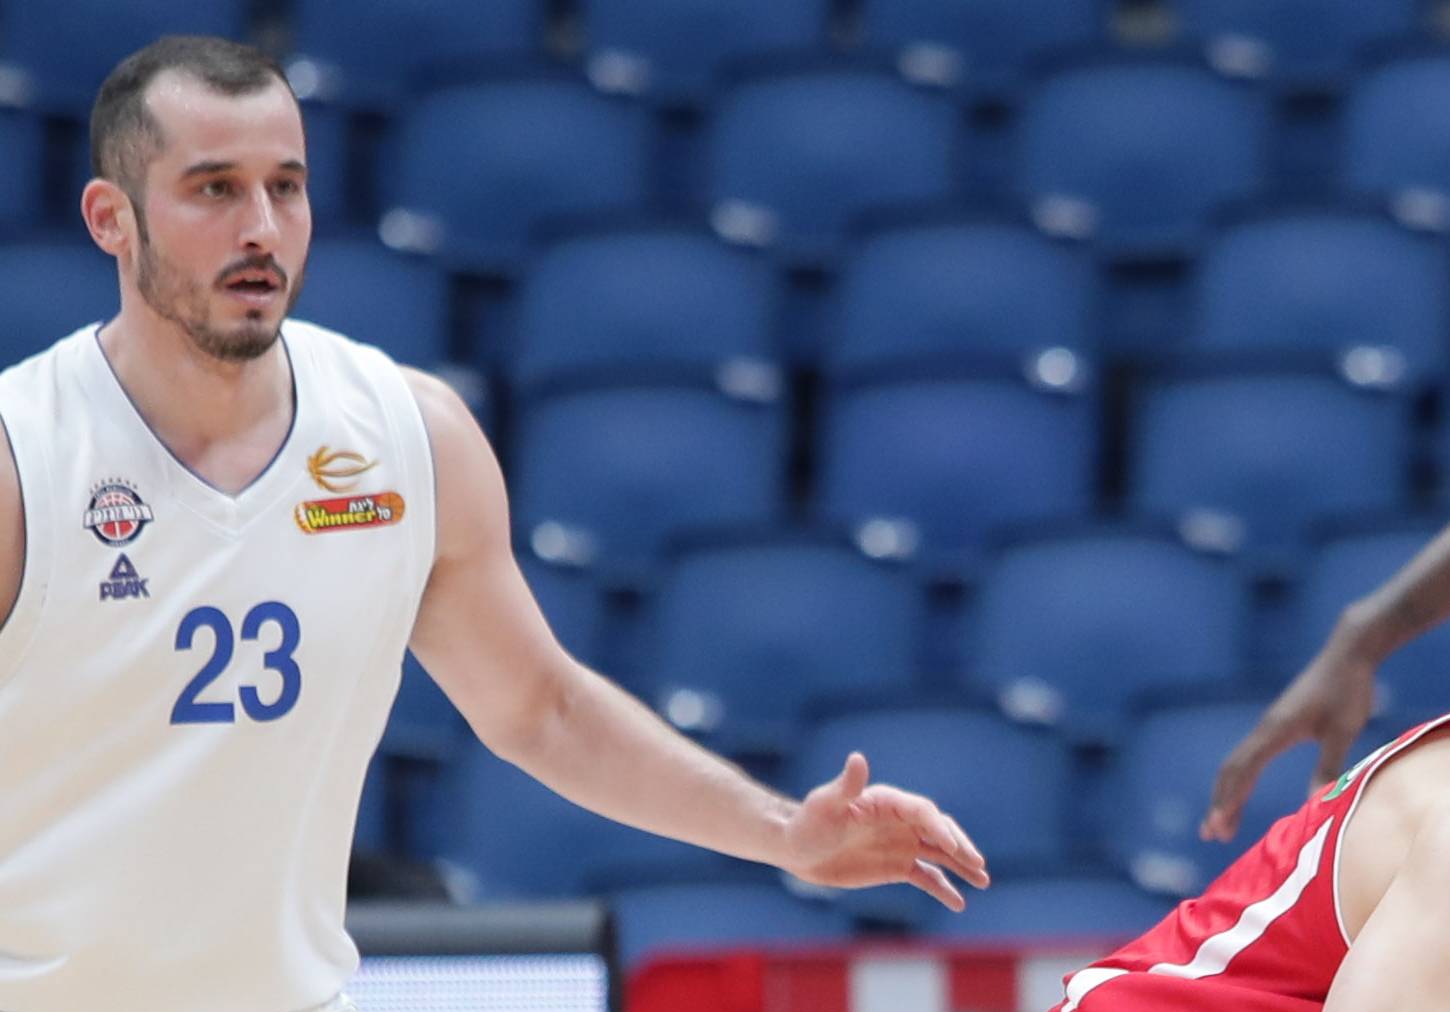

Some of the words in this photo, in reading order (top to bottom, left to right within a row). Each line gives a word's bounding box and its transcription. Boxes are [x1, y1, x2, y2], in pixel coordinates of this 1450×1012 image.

[306, 507, 377, 529] Winner
[99, 579, 151, 601] PEAK
[169, 600, 301, 725] 23
